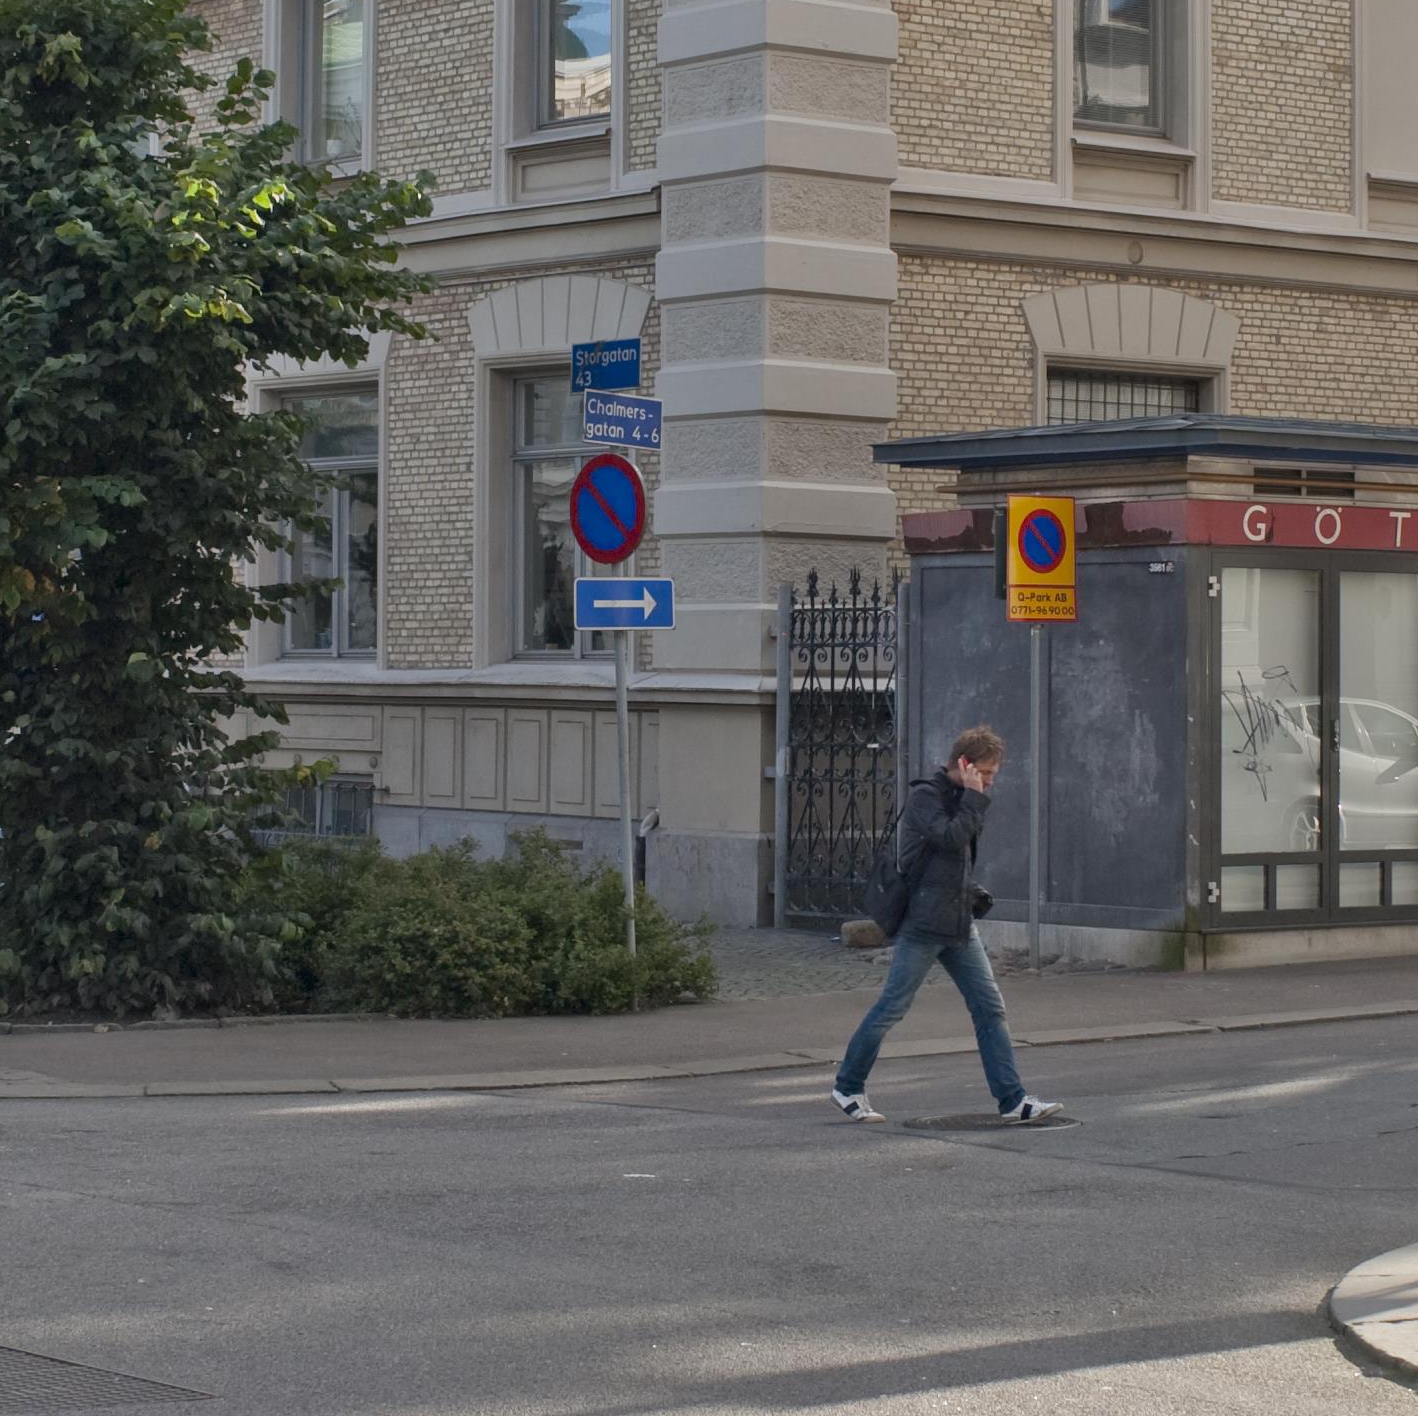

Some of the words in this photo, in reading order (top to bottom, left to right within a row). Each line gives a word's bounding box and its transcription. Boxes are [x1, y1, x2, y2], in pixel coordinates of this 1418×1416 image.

[576, 347, 637, 367] Storgatan
[575, 371, 592, 387] 43
[587, 398, 654, 420] Chalmers-
[586, 422, 625, 439] gatan
[1017, 592, 1051, 602] Q-Park
[1055, 592, 1068, 602] AB
